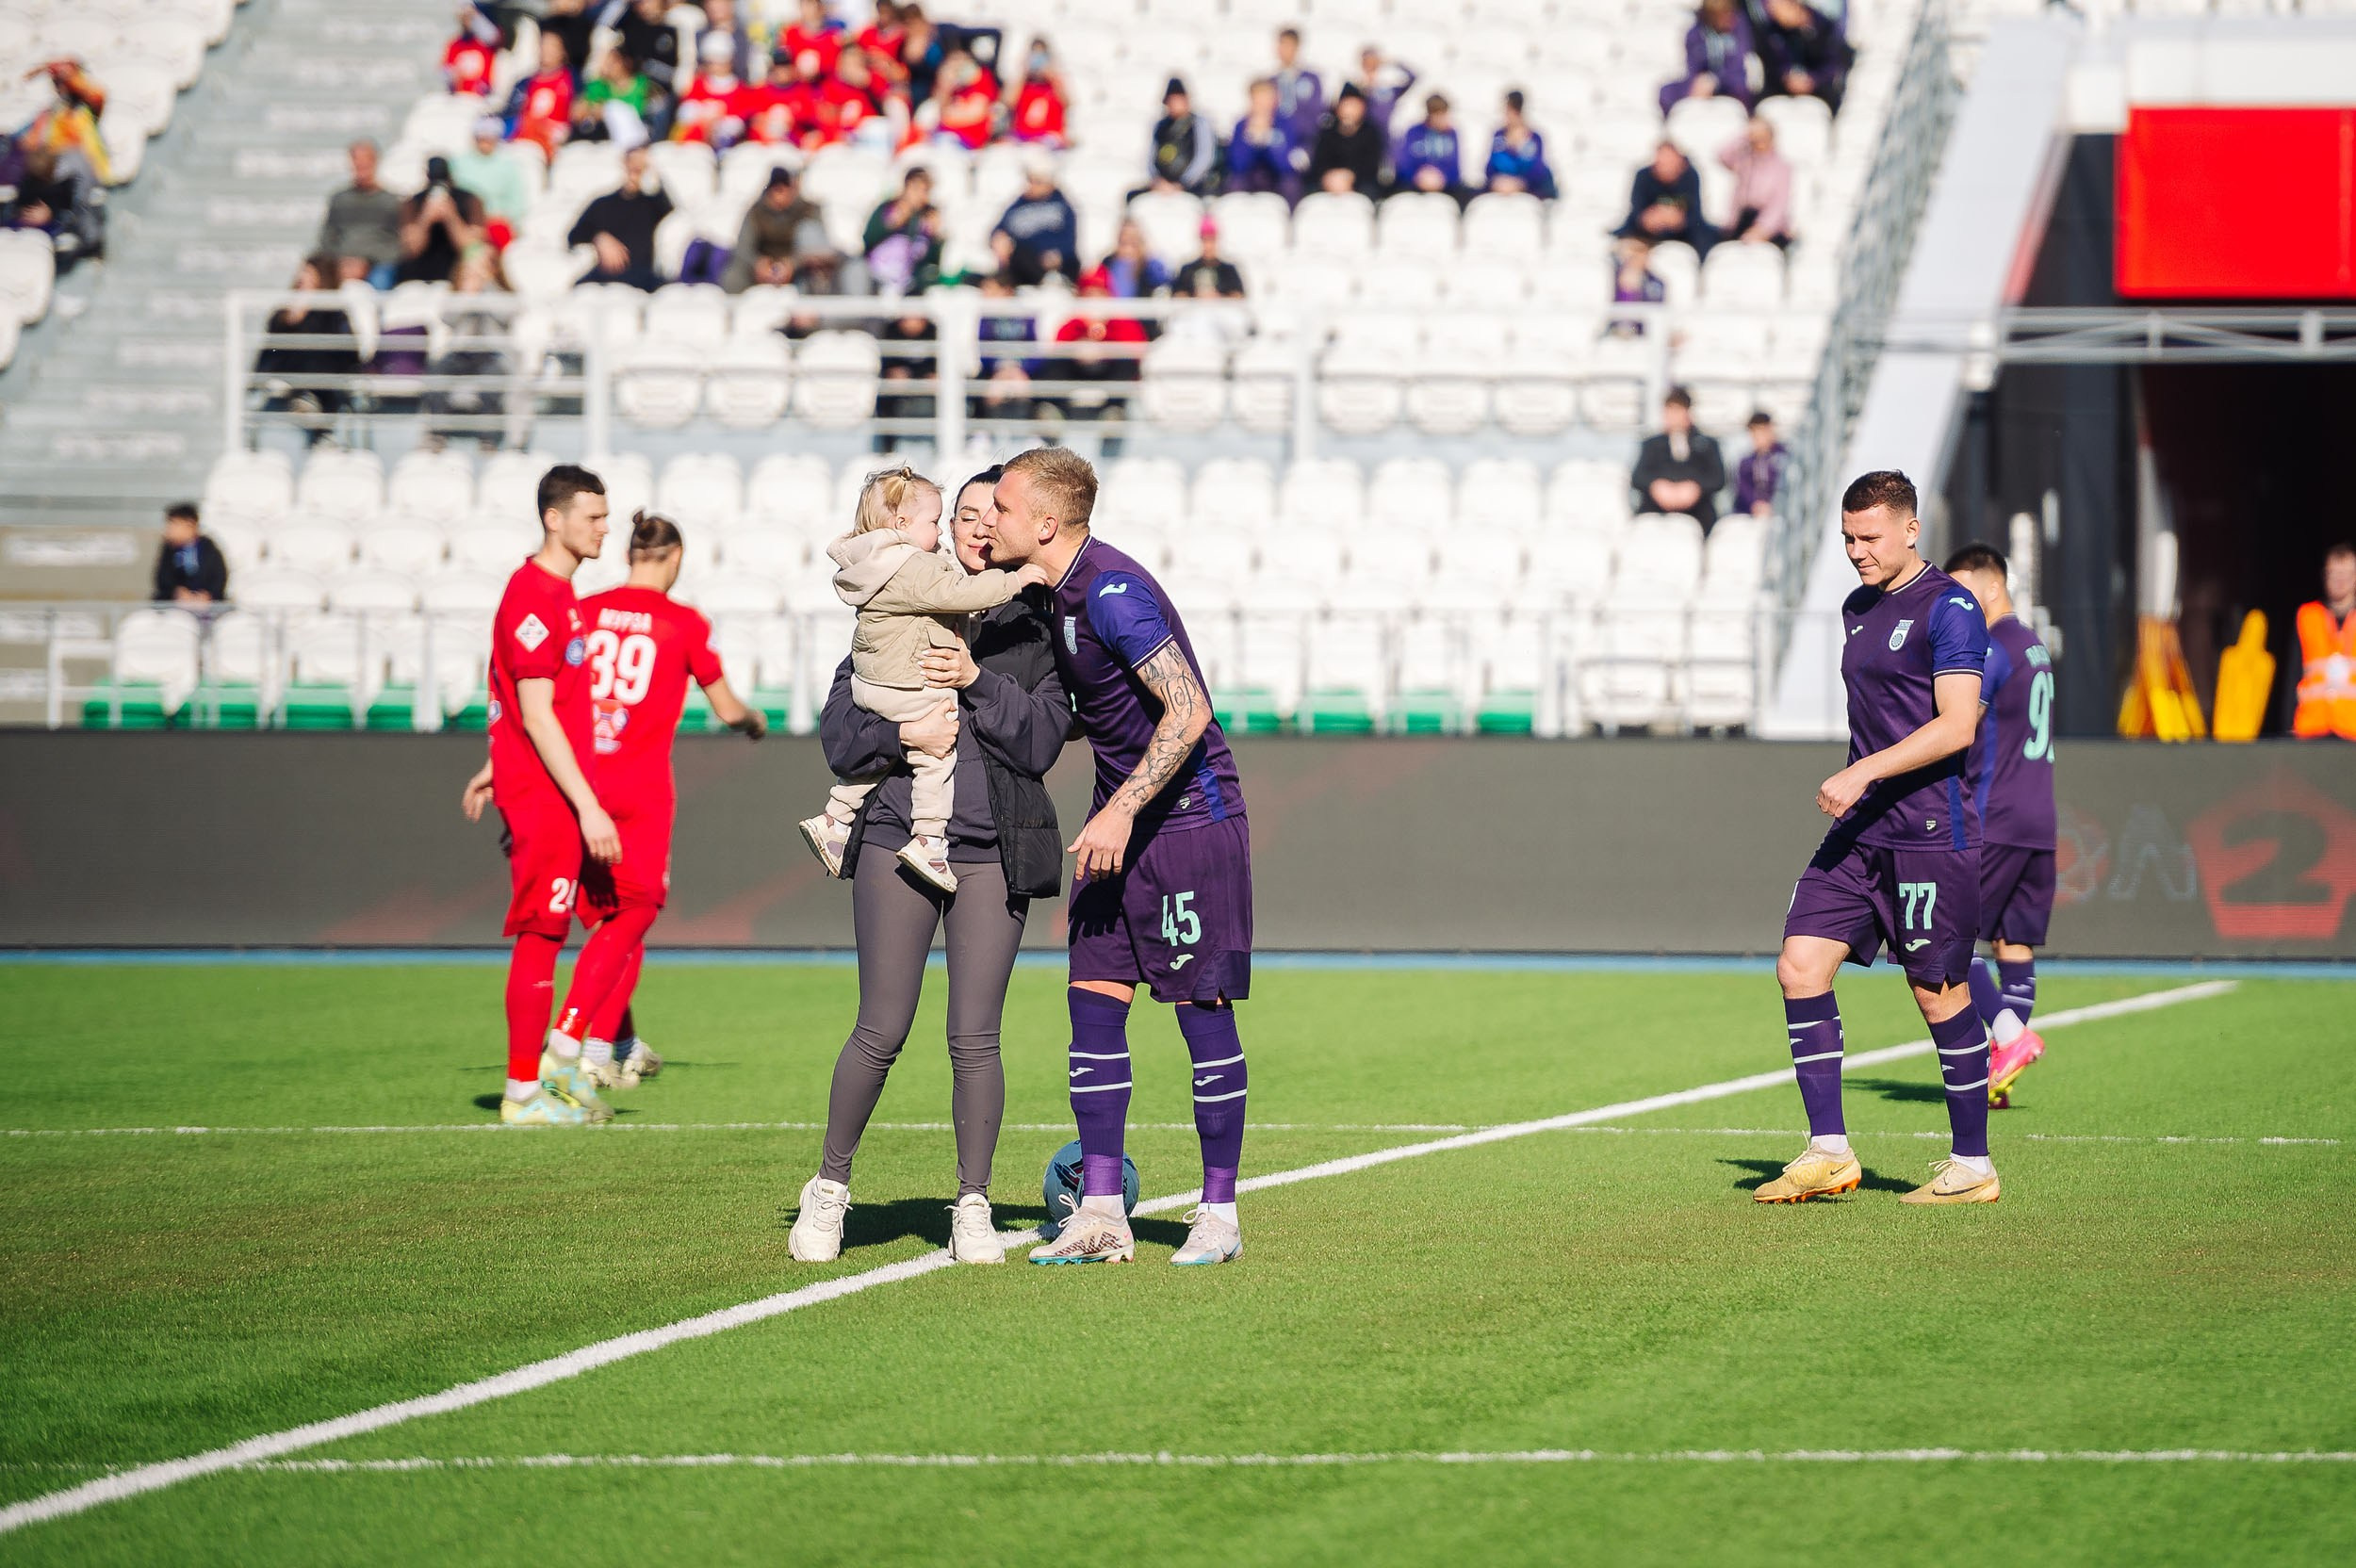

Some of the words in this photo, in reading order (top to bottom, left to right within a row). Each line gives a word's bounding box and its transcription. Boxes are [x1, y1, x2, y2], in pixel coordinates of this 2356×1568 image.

[587, 629, 657, 706] 39
[2221, 809, 2333, 906] 2
[1162, 890, 1202, 947] 45
[1898, 882, 1937, 930] 77
